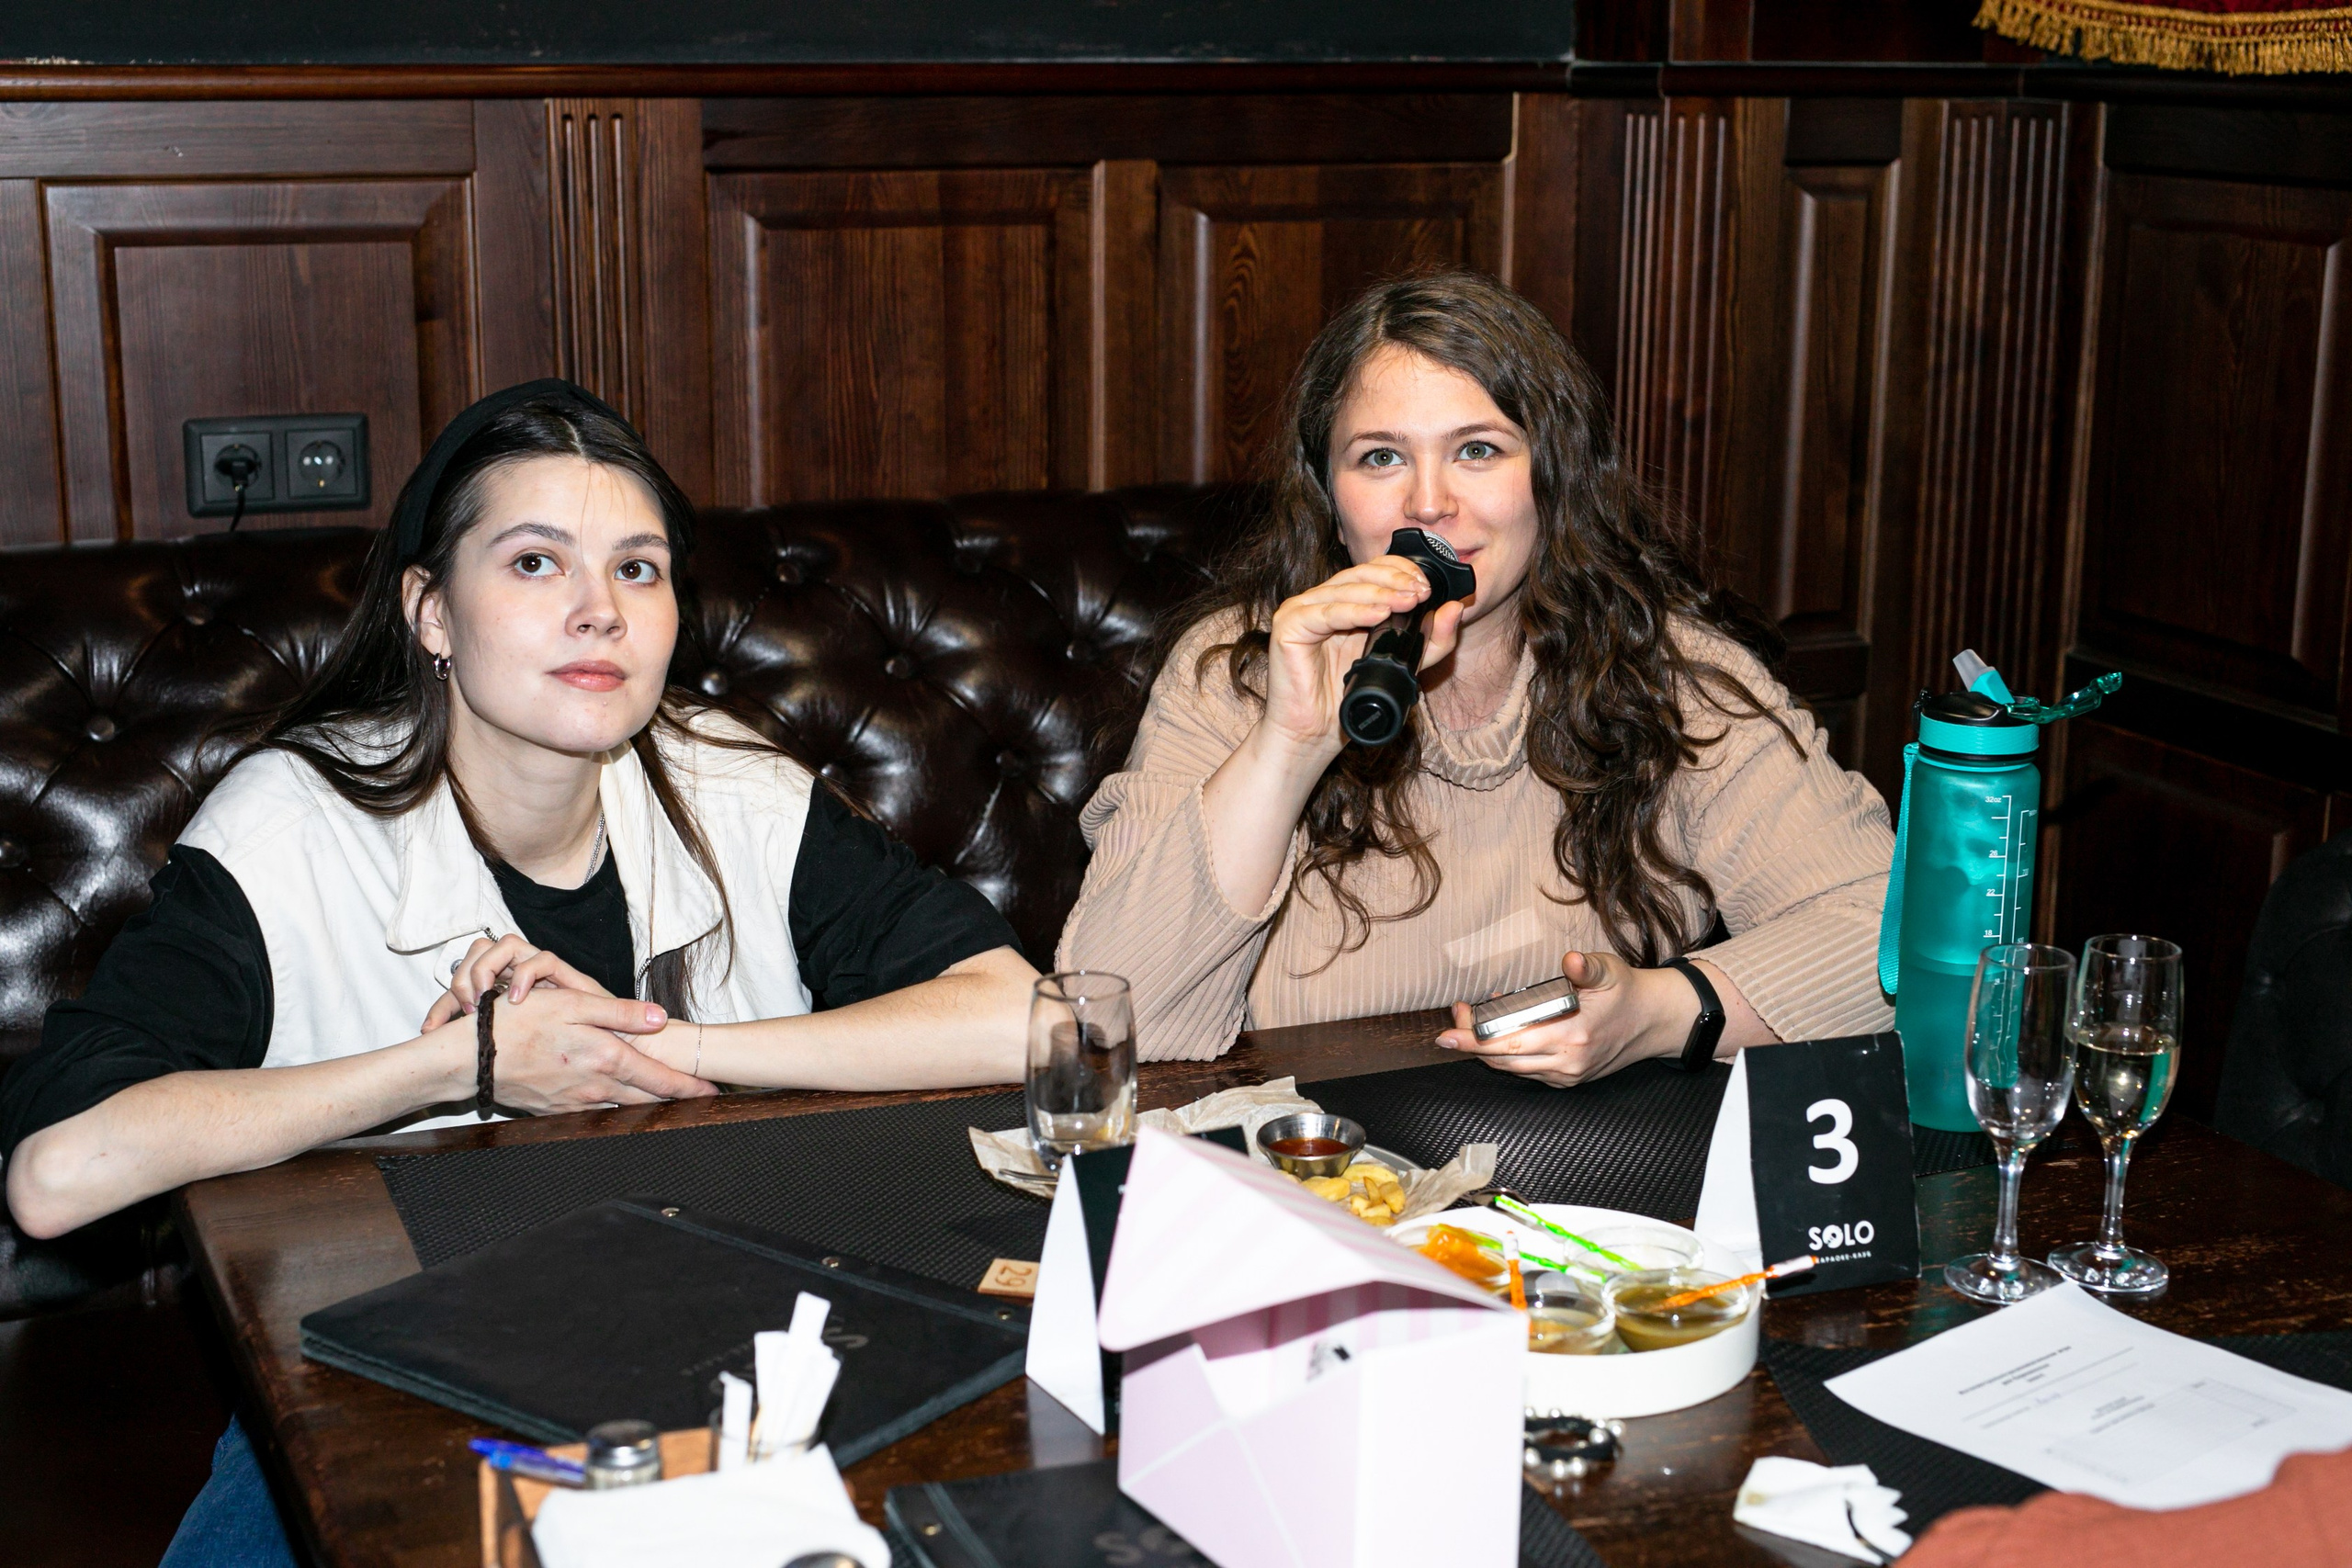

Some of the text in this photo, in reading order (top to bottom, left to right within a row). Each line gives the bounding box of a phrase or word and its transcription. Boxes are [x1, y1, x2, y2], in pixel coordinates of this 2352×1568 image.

[1984, 795, 2002, 804] 32oz
[1806, 1098, 1860, 1185] 3
[1808, 1220, 1875, 1251] SOLO
